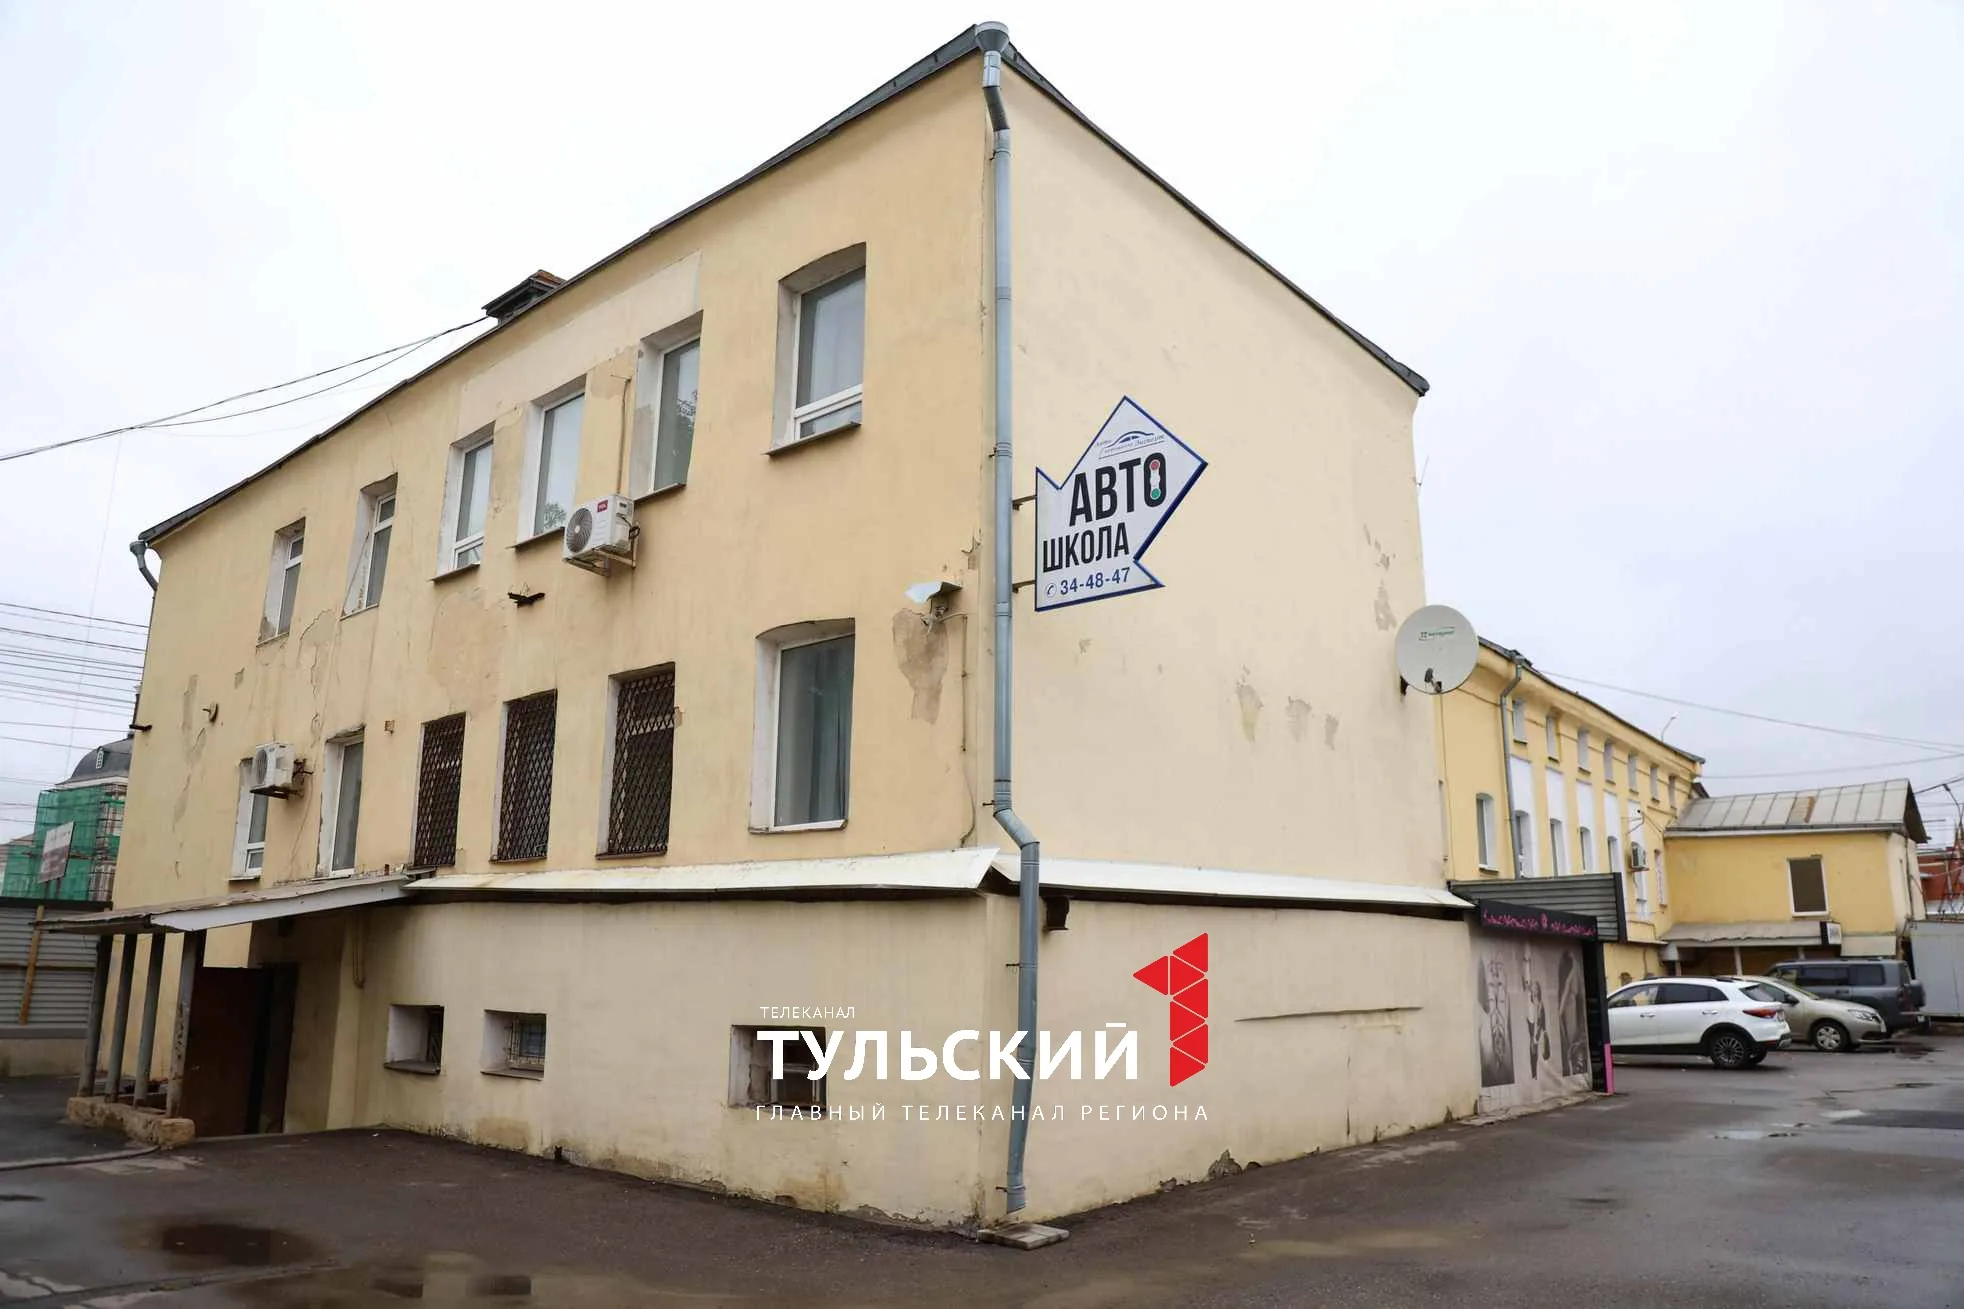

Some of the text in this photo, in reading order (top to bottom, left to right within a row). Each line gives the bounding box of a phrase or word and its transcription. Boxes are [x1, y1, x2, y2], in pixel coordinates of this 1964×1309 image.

[1069, 452, 1167, 527] АВТО
[1042, 522, 1130, 573] ШКОЛА
[1060, 567, 1130, 596] 34-48-47
